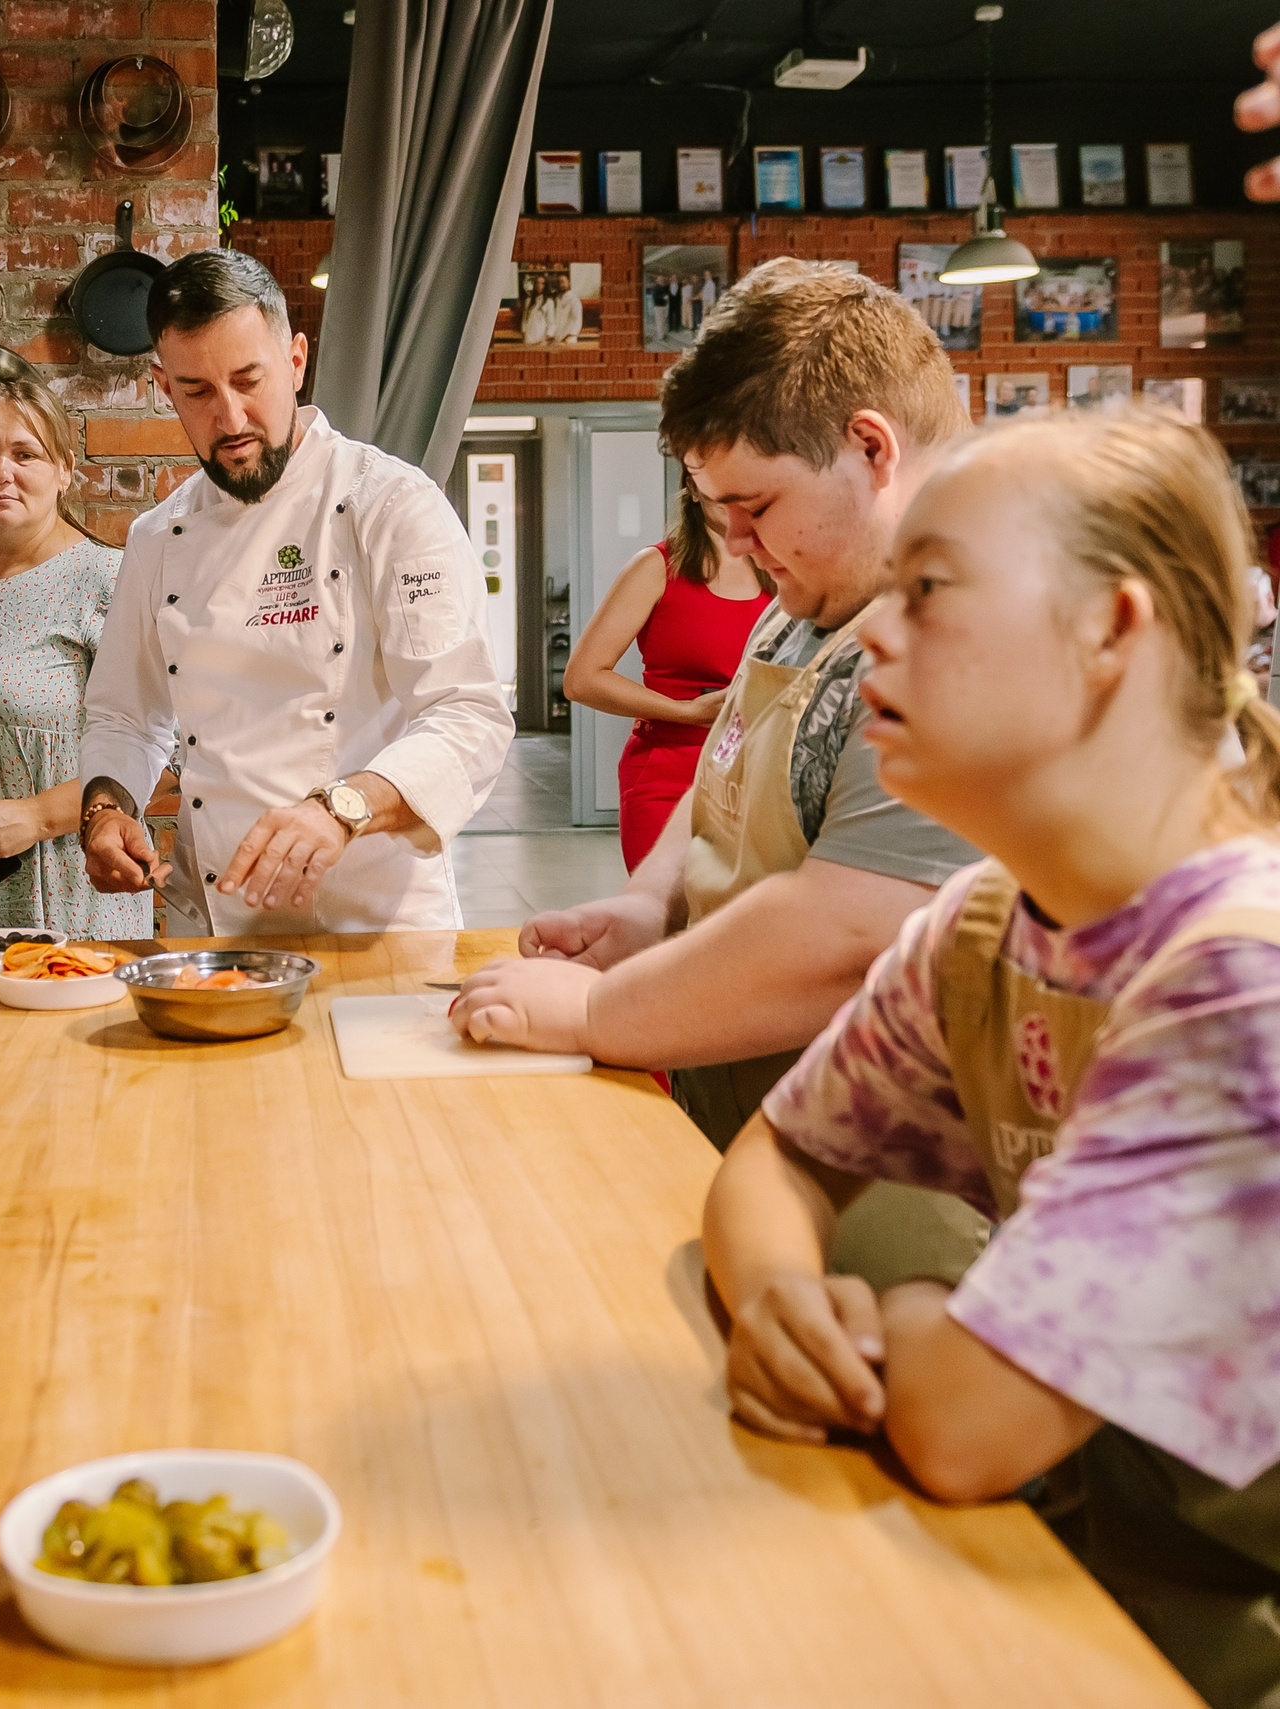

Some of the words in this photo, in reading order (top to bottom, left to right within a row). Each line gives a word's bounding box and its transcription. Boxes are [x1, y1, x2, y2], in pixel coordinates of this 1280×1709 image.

[261, 565, 313, 585] АРТИШОК
[401, 571, 441, 587] Вкусно
[276, 591, 298, 601] ШЕФ
[261, 605, 319, 626] SCHARF
